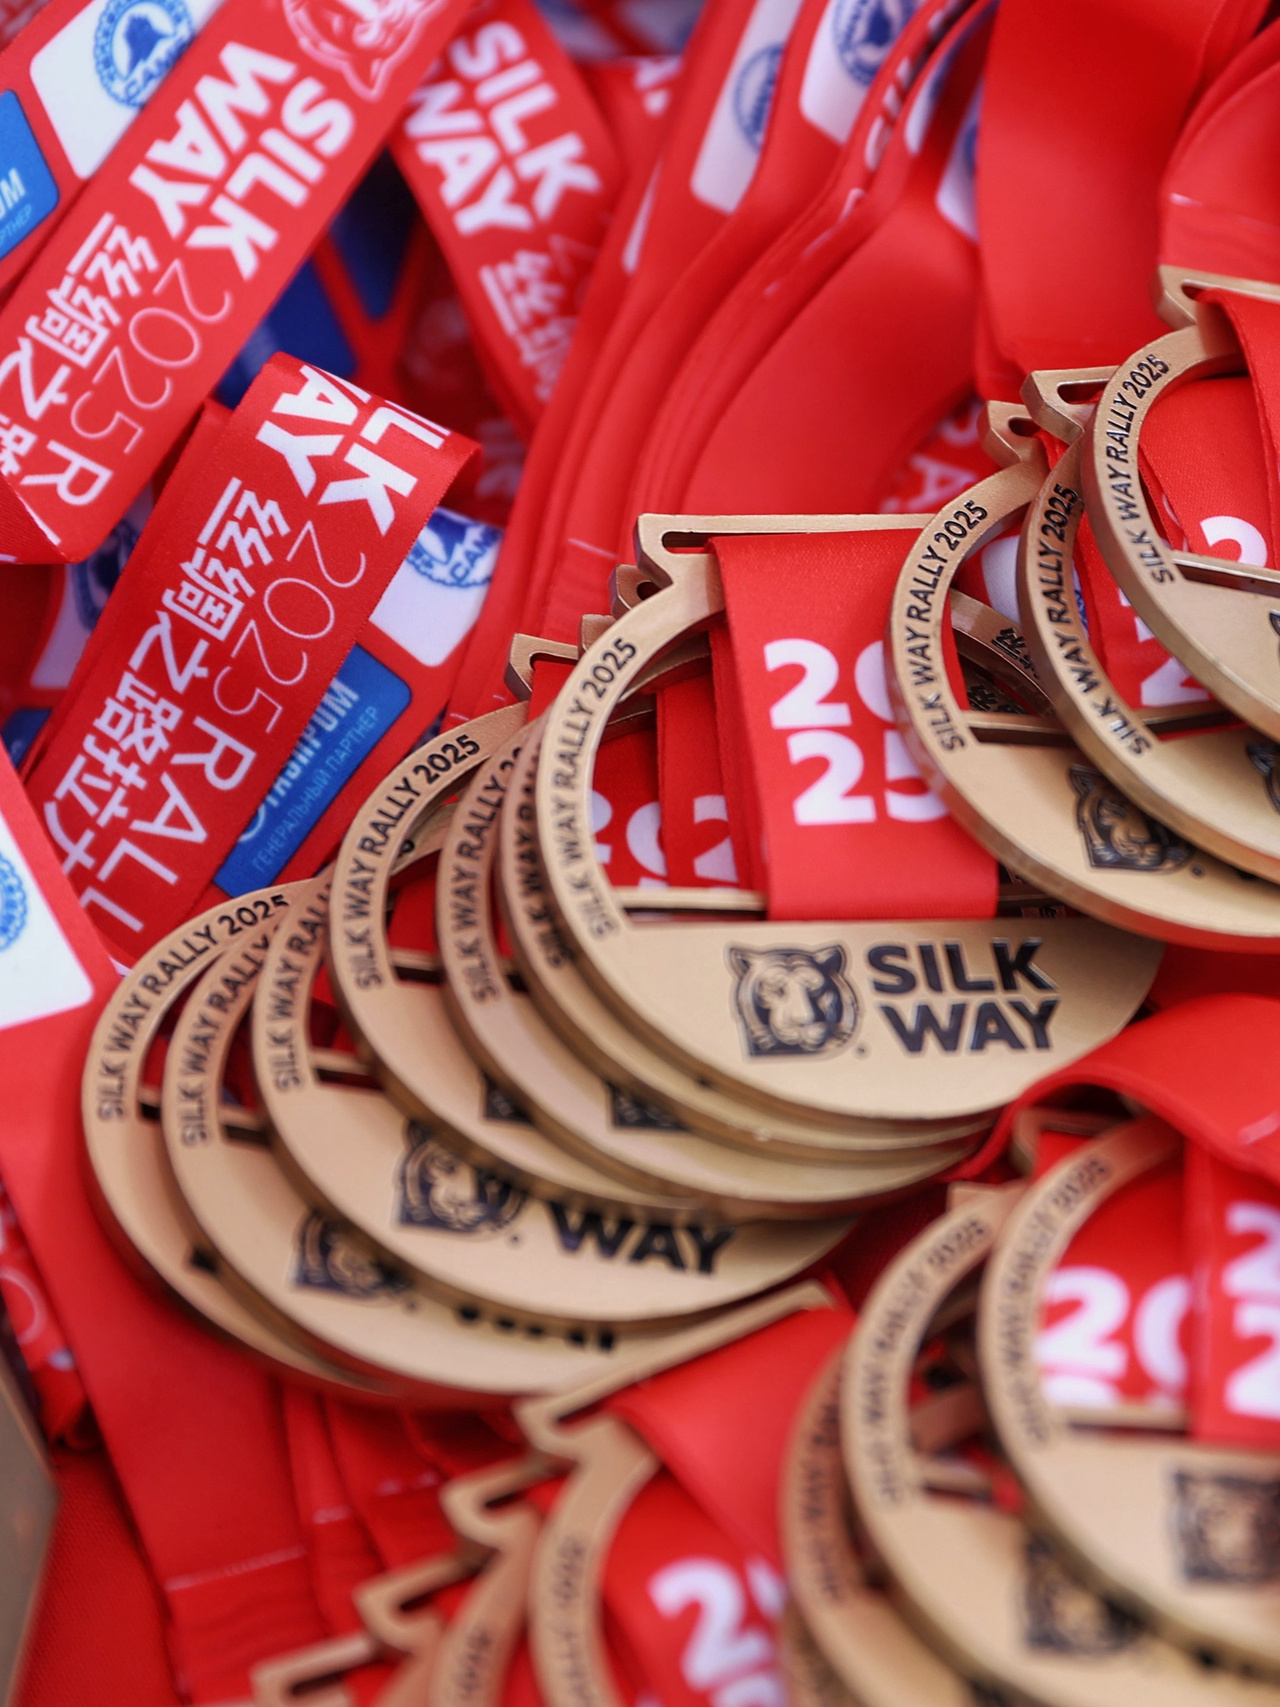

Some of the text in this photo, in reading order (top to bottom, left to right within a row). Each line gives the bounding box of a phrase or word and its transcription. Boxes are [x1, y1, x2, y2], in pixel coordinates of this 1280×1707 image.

[129, 41, 298, 239] WAY
[448, 20, 603, 222] SILK
[184, 76, 356, 281] SILK
[256, 364, 372, 498] AY
[317, 399, 451, 536] LK
[1105, 353, 1176, 585] SILK WAY RALLY 2025
[934, 499, 989, 552] 2025
[906, 544, 950, 624] RALLY
[1038, 482, 1153, 756] SILK WAY RALLY 2025
[582, 636, 638, 701] 2025
[904, 626, 937, 688] WAY
[412, 733, 482, 786] 2025
[552, 695, 595, 793] RALLY
[919, 690, 967, 753] SILK
[358, 776, 424, 860] RALLY
[549, 796, 587, 864] WAY
[343, 857, 378, 922] WAY
[141, 924, 220, 996] RALLY
[866, 935, 1056, 998] SILK
[876, 998, 1063, 1054] WAY
